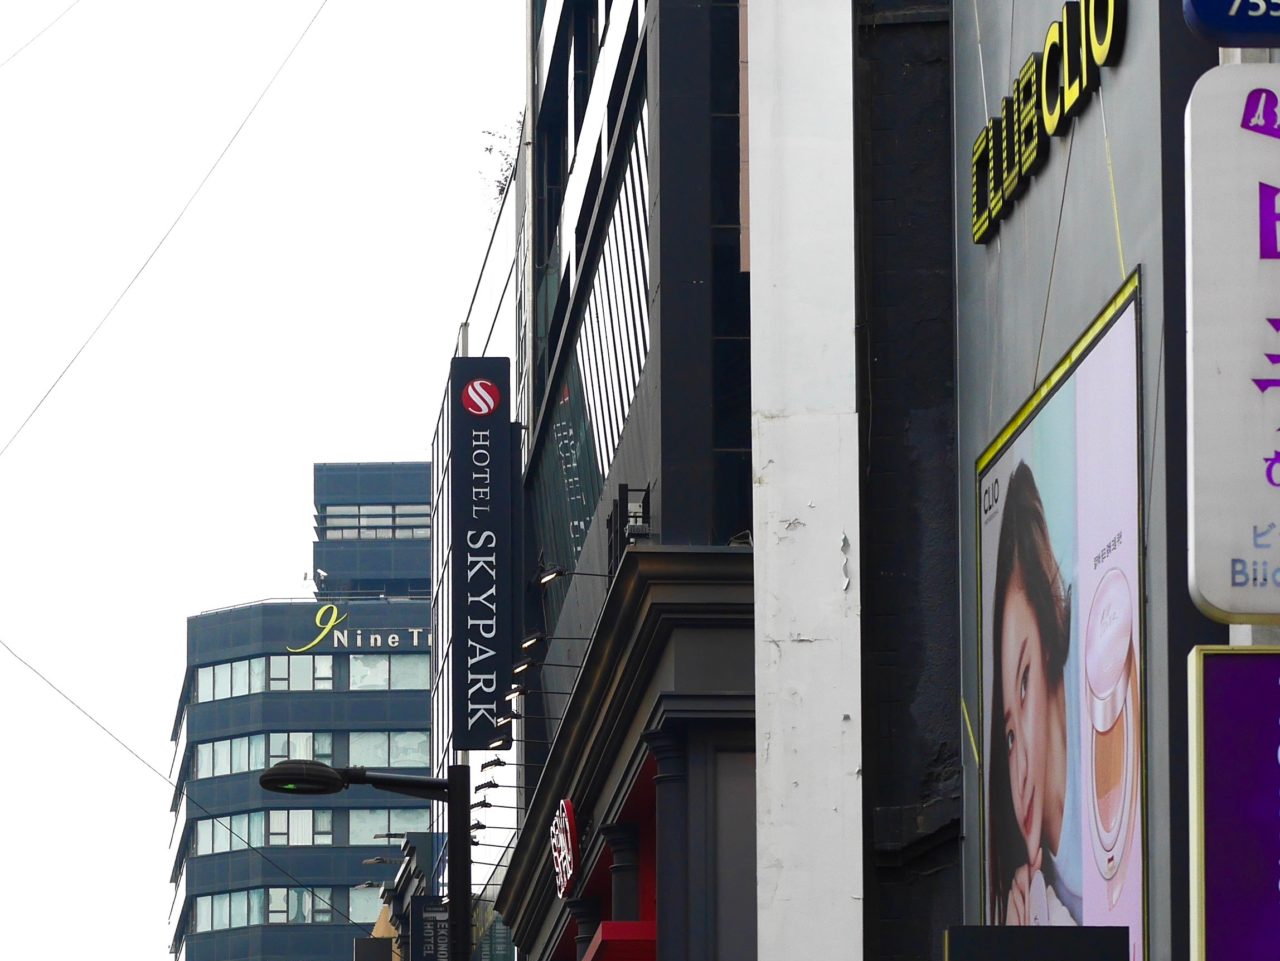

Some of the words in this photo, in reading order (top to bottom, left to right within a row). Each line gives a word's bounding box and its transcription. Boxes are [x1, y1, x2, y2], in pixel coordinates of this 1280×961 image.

[971, 52, 1039, 245] CLUB
[471, 428, 490, 519] HOTEL
[983, 477, 1000, 515] CLIO
[333, 628, 400, 648] Nine
[466, 530, 498, 730] SKYPARK
